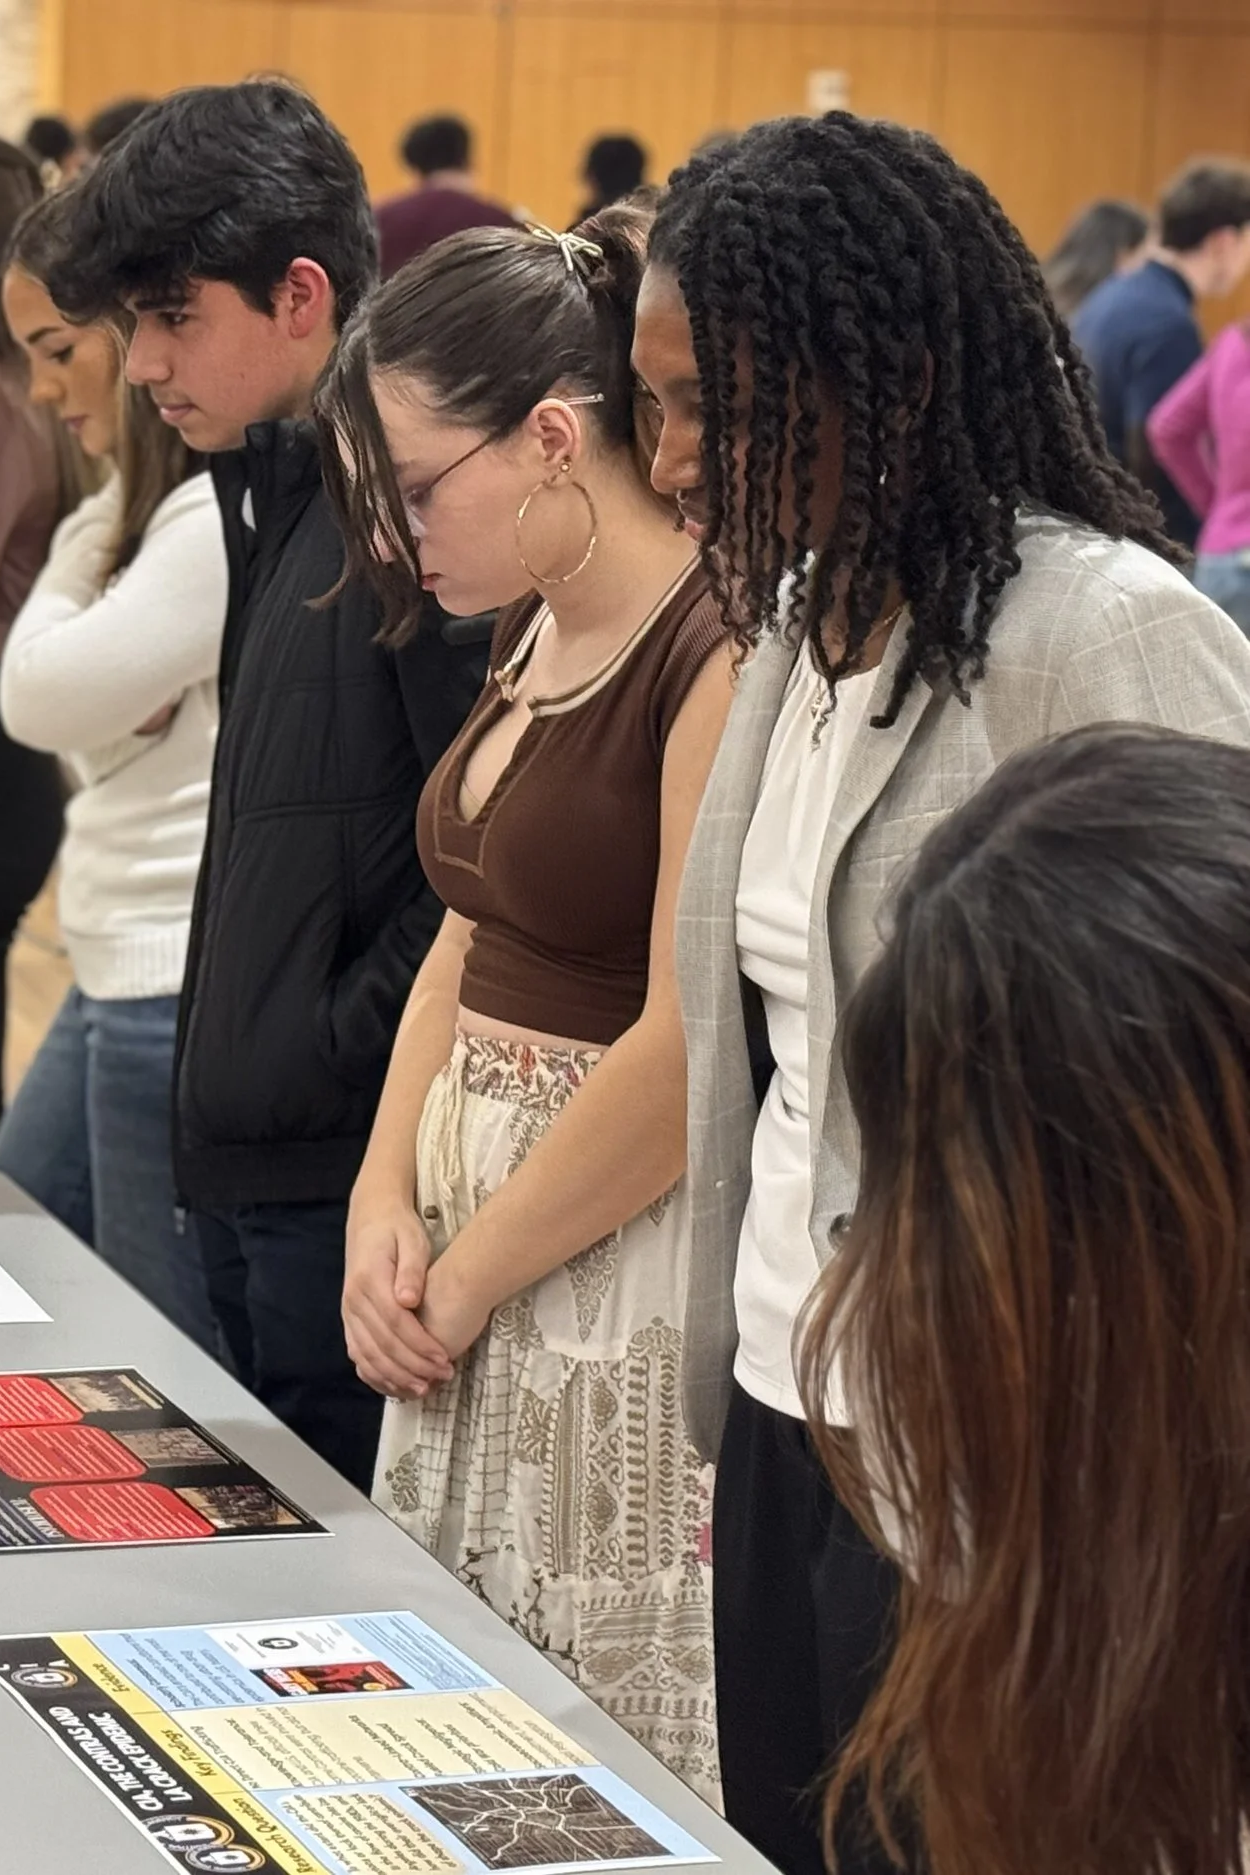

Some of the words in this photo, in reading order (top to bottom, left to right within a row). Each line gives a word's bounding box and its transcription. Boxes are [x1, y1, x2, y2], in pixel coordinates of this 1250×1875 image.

[92, 1663, 129, 1692] Evidence
[49, 1706, 83, 1726] AND
[89, 1712, 144, 1754] EPIDEMIC
[161, 1729, 199, 1761] Findings
[68, 1727, 124, 1772] CONTRAS
[109, 1771, 143, 1791] THE
[129, 1754, 176, 1787] CRACK
[193, 1761, 216, 1776] Key
[131, 1789, 163, 1811] CIA,
[163, 1785, 192, 1801] LA
[233, 1797, 277, 1833] Question
[266, 1834, 314, 1873] Research
